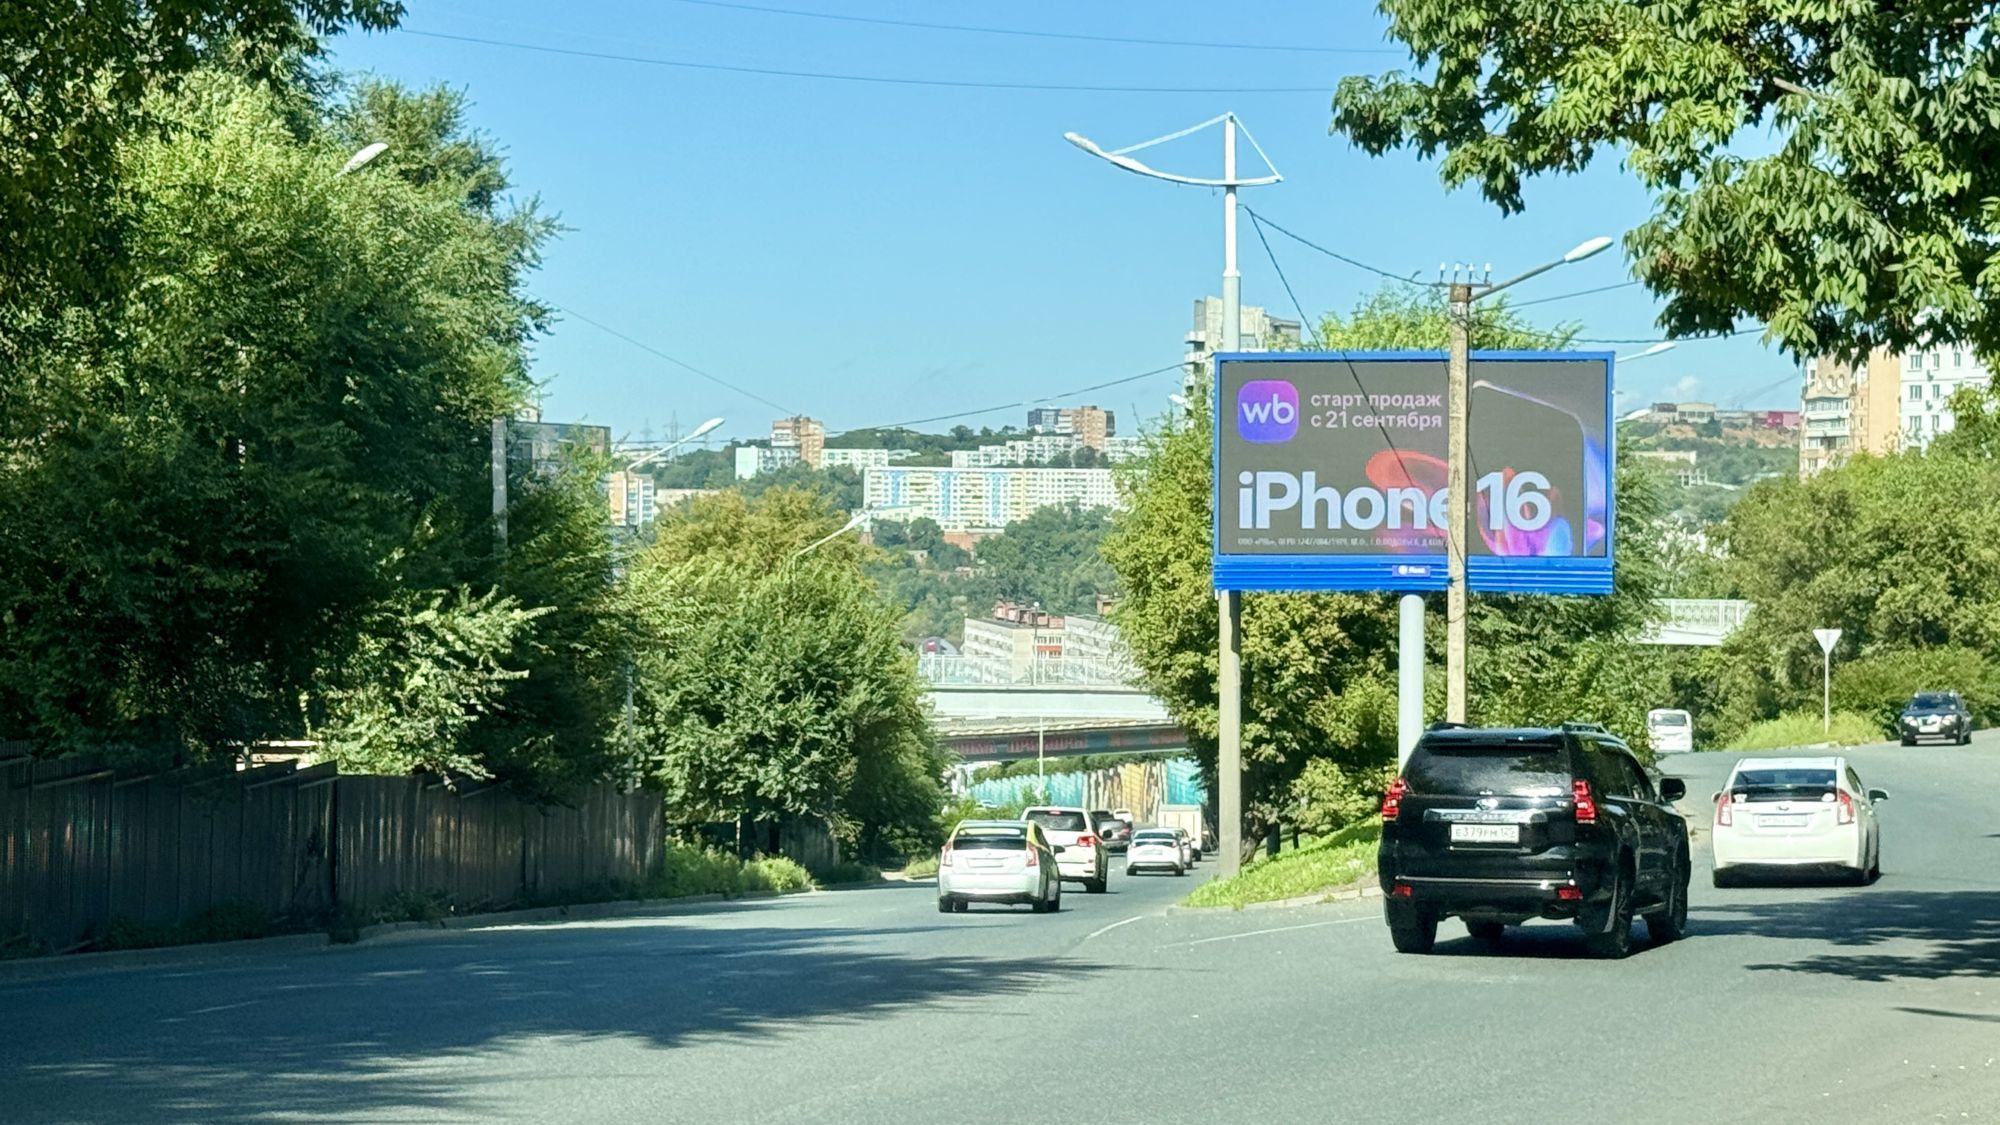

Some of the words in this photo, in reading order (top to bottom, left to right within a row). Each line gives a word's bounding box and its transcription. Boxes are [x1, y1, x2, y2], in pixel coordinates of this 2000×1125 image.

[1241, 393, 1295, 425] wb
[1310, 394, 1364, 410] старт
[1368, 394, 1443, 411] продаж
[1310, 414, 1322, 428] с
[1325, 410, 1348, 429] 21
[1352, 411, 1443, 432] сентября
[1476, 471, 1552, 532] 16
